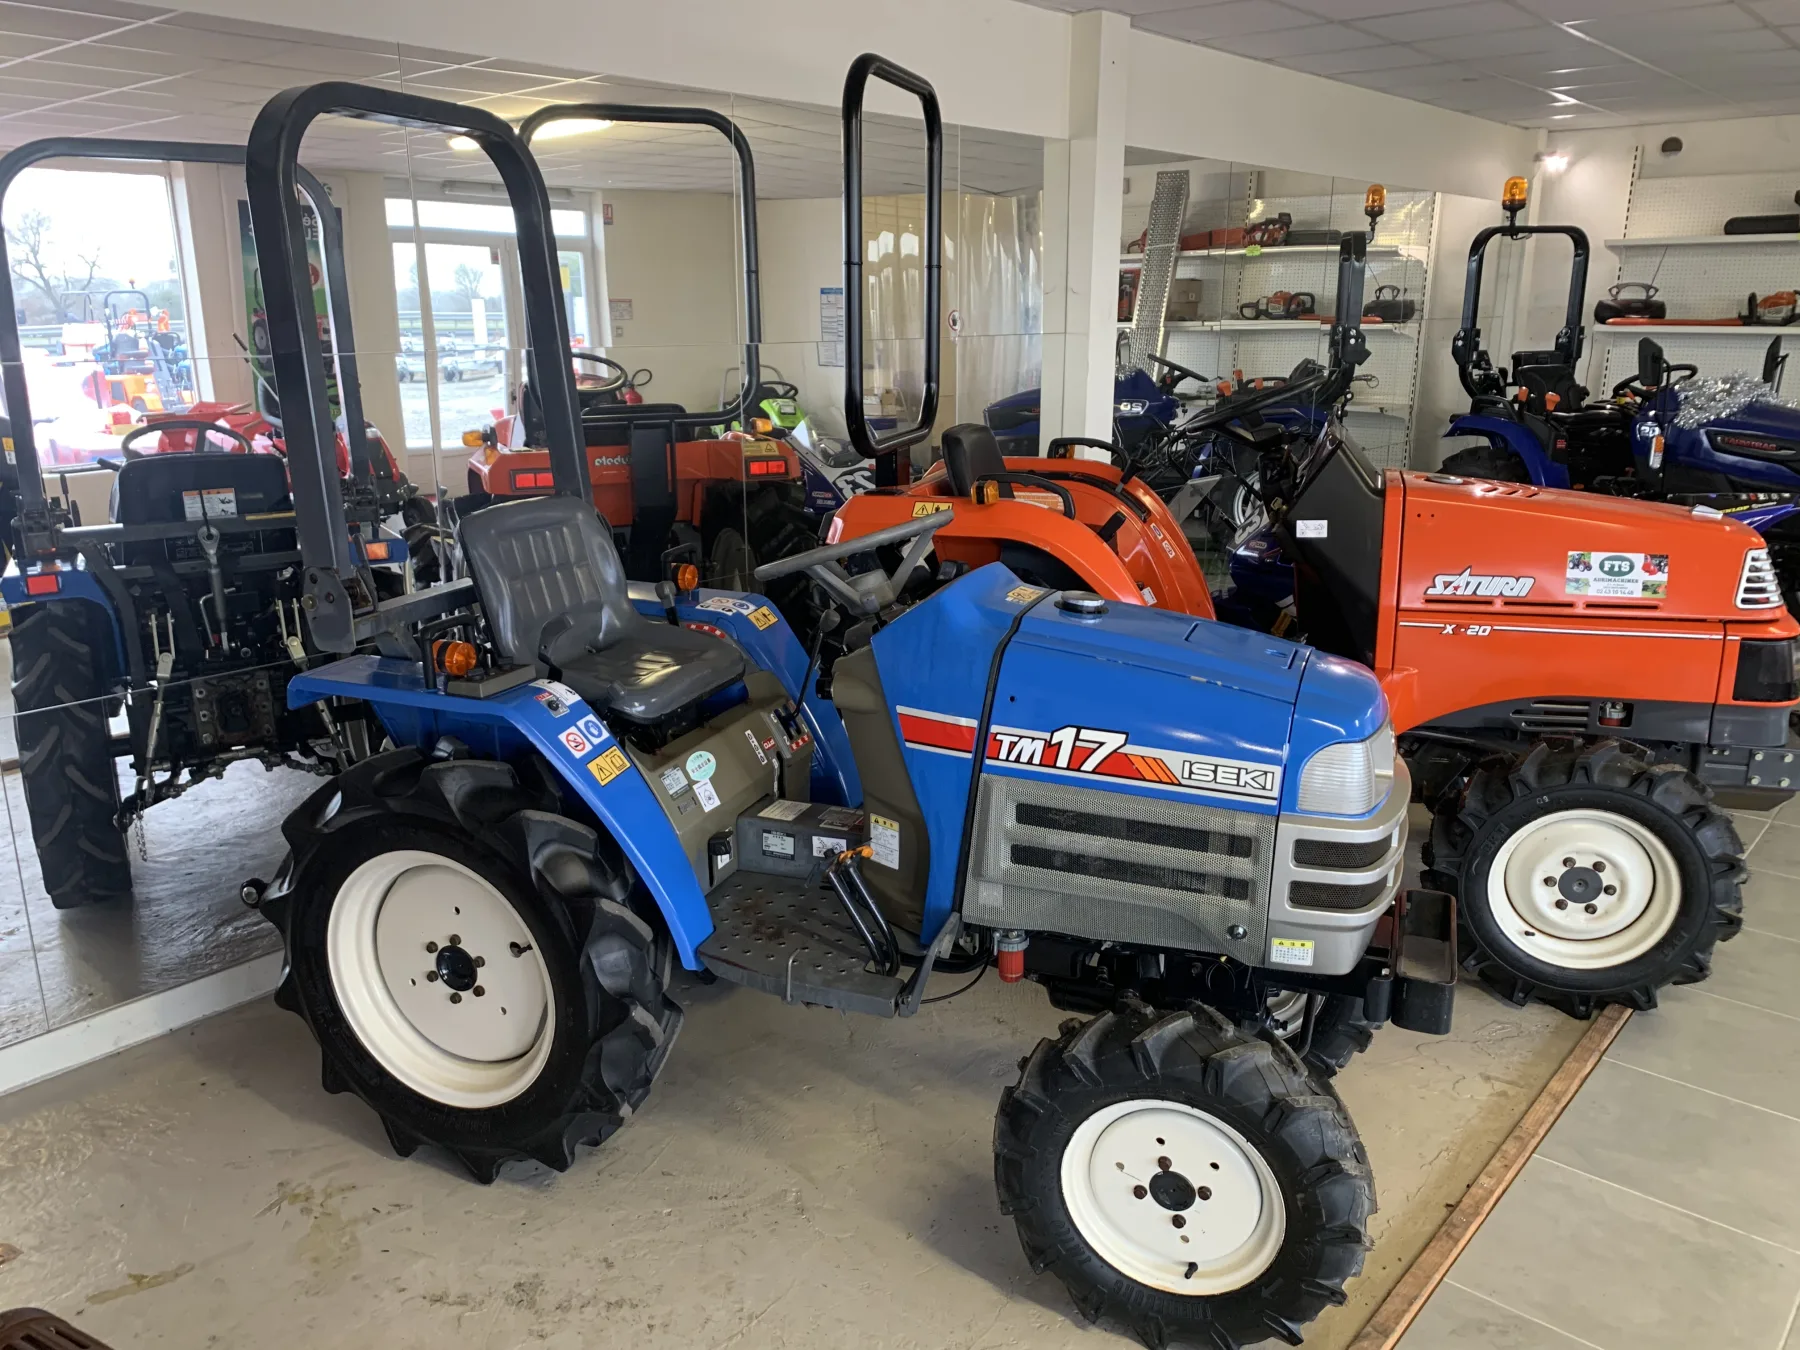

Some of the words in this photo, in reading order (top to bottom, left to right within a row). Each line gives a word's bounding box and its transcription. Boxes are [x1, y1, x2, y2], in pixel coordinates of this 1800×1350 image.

[1423, 565, 1536, 598] SATURN
[1603, 560, 1631, 572] FTS
[1181, 759, 1275, 792] ISEKI
